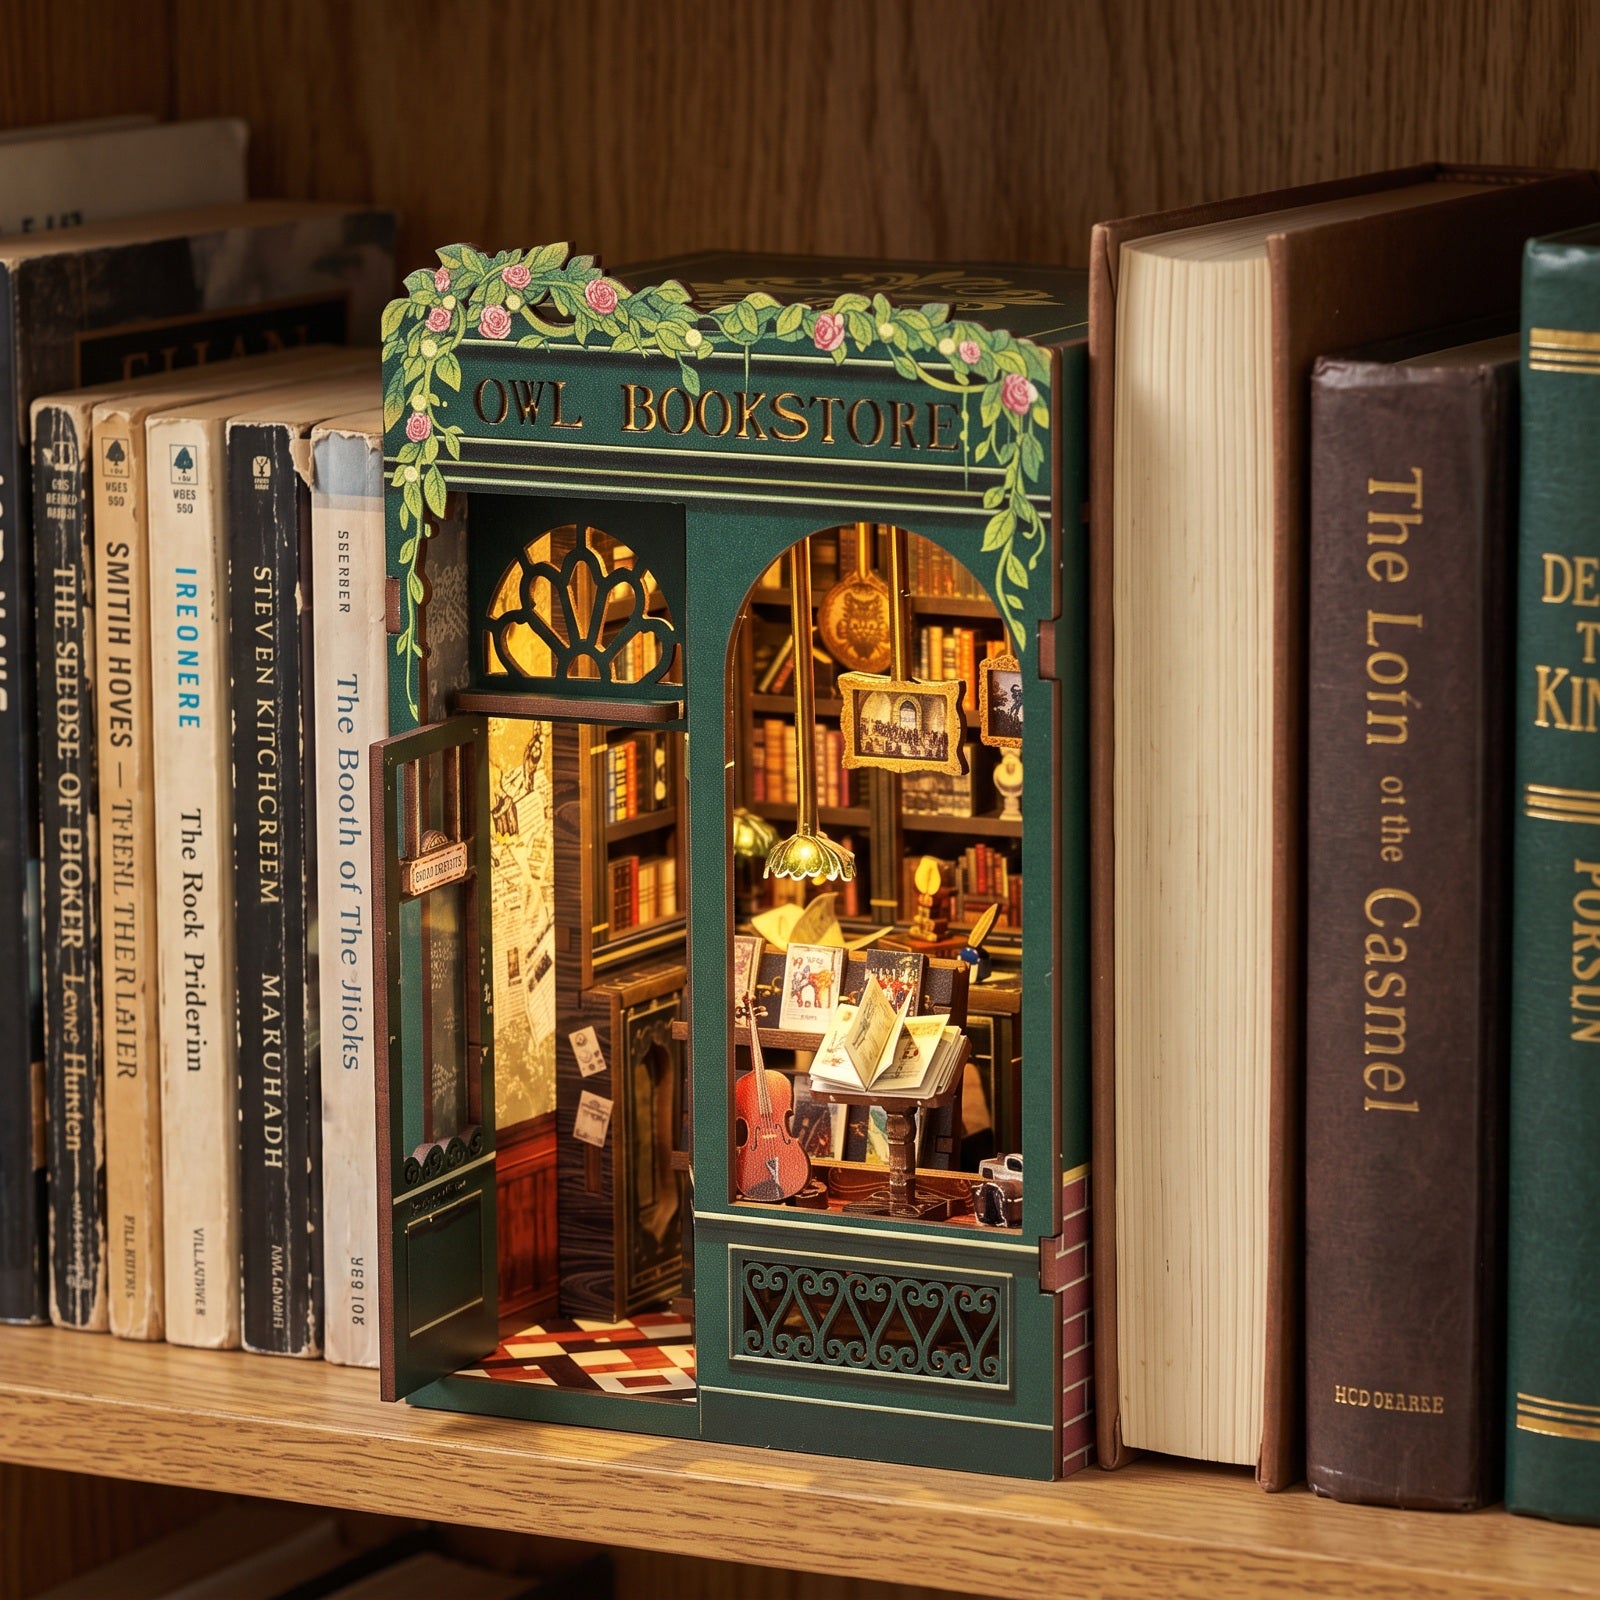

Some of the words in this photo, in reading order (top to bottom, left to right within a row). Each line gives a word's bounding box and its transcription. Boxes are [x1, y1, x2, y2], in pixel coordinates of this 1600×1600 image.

[473, 377, 583, 430] OWL
[620, 383, 960, 452] BOOKSTORE
[1367, 467, 1423, 582] The
[54, 564, 78, 628] THE
[106, 541, 132, 645] SMITIH
[253, 566, 274, 685] STEVEN
[175, 567, 200, 728] IREONERE
[108, 656, 133, 748] HOVES
[337, 673, 360, 734] The
[57, 771, 82, 816] OF
[180, 808, 203, 860] The
[257, 698, 280, 904] KITCHCREEM
[338, 747, 362, 846] Booth
[339, 860, 363, 895] of
[1380, 814, 1411, 862] the
[182, 871, 205, 939] Rock
[341, 906, 363, 965] The
[1364, 888, 1421, 1112] Casmel
[262, 973, 282, 1168] MARUHADH
